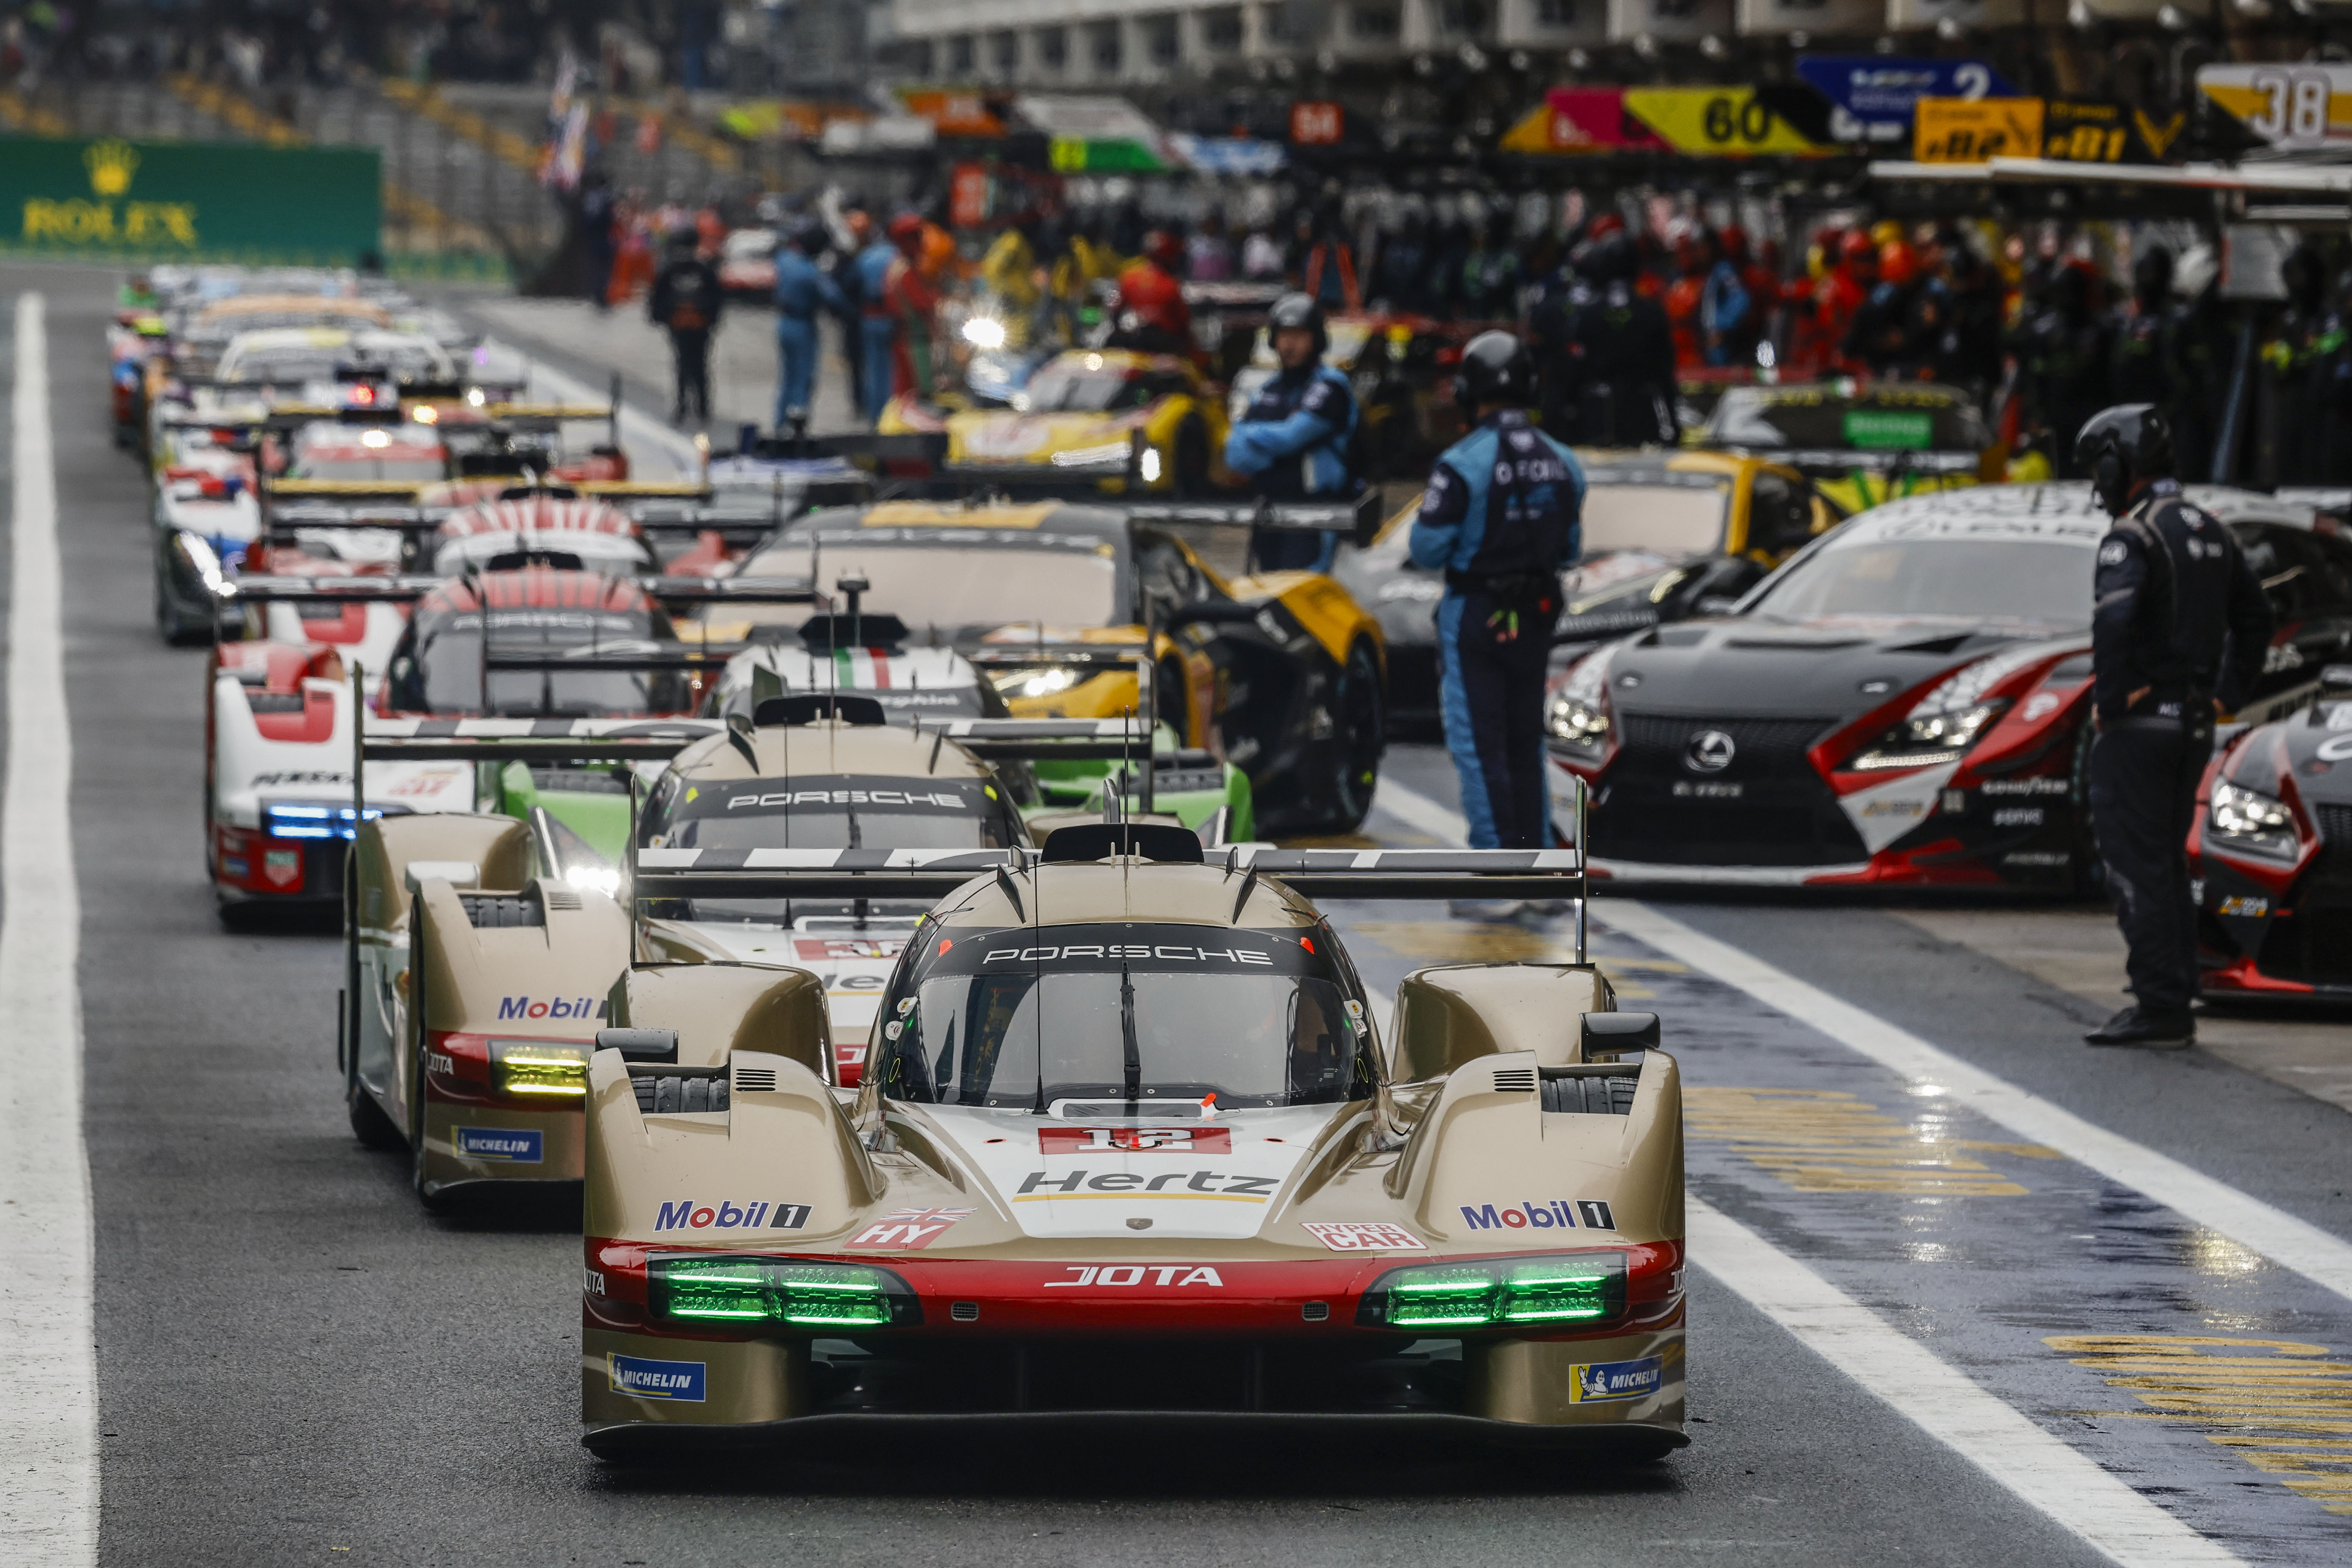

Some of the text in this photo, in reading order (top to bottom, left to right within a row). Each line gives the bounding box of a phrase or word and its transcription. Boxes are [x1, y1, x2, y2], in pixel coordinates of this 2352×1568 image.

[2251, 66, 2332, 146] 38
[1705, 98, 1770, 142] 60
[727, 790, 967, 810] PORSCHE
[982, 944, 1274, 966] PORSCHE
[497, 995, 593, 1020] Mobil
[469, 1138, 531, 1153] MICHELIN
[1076, 1128, 1196, 1151] 12
[1016, 1170, 1280, 1195] Hertz
[654, 1201, 770, 1231] Mobil
[1460, 1200, 1577, 1230] Mobil
[853, 1225, 945, 1243] HY
[1308, 1224, 1398, 1233] HYPER
[1323, 1233, 1420, 1248] CAR
[1044, 1266, 1224, 1287] JOTA
[1667, 1270, 1684, 1294] JO
[624, 1370, 692, 1389] MICHELIN
[1610, 1368, 1659, 1389] MICHELIN
